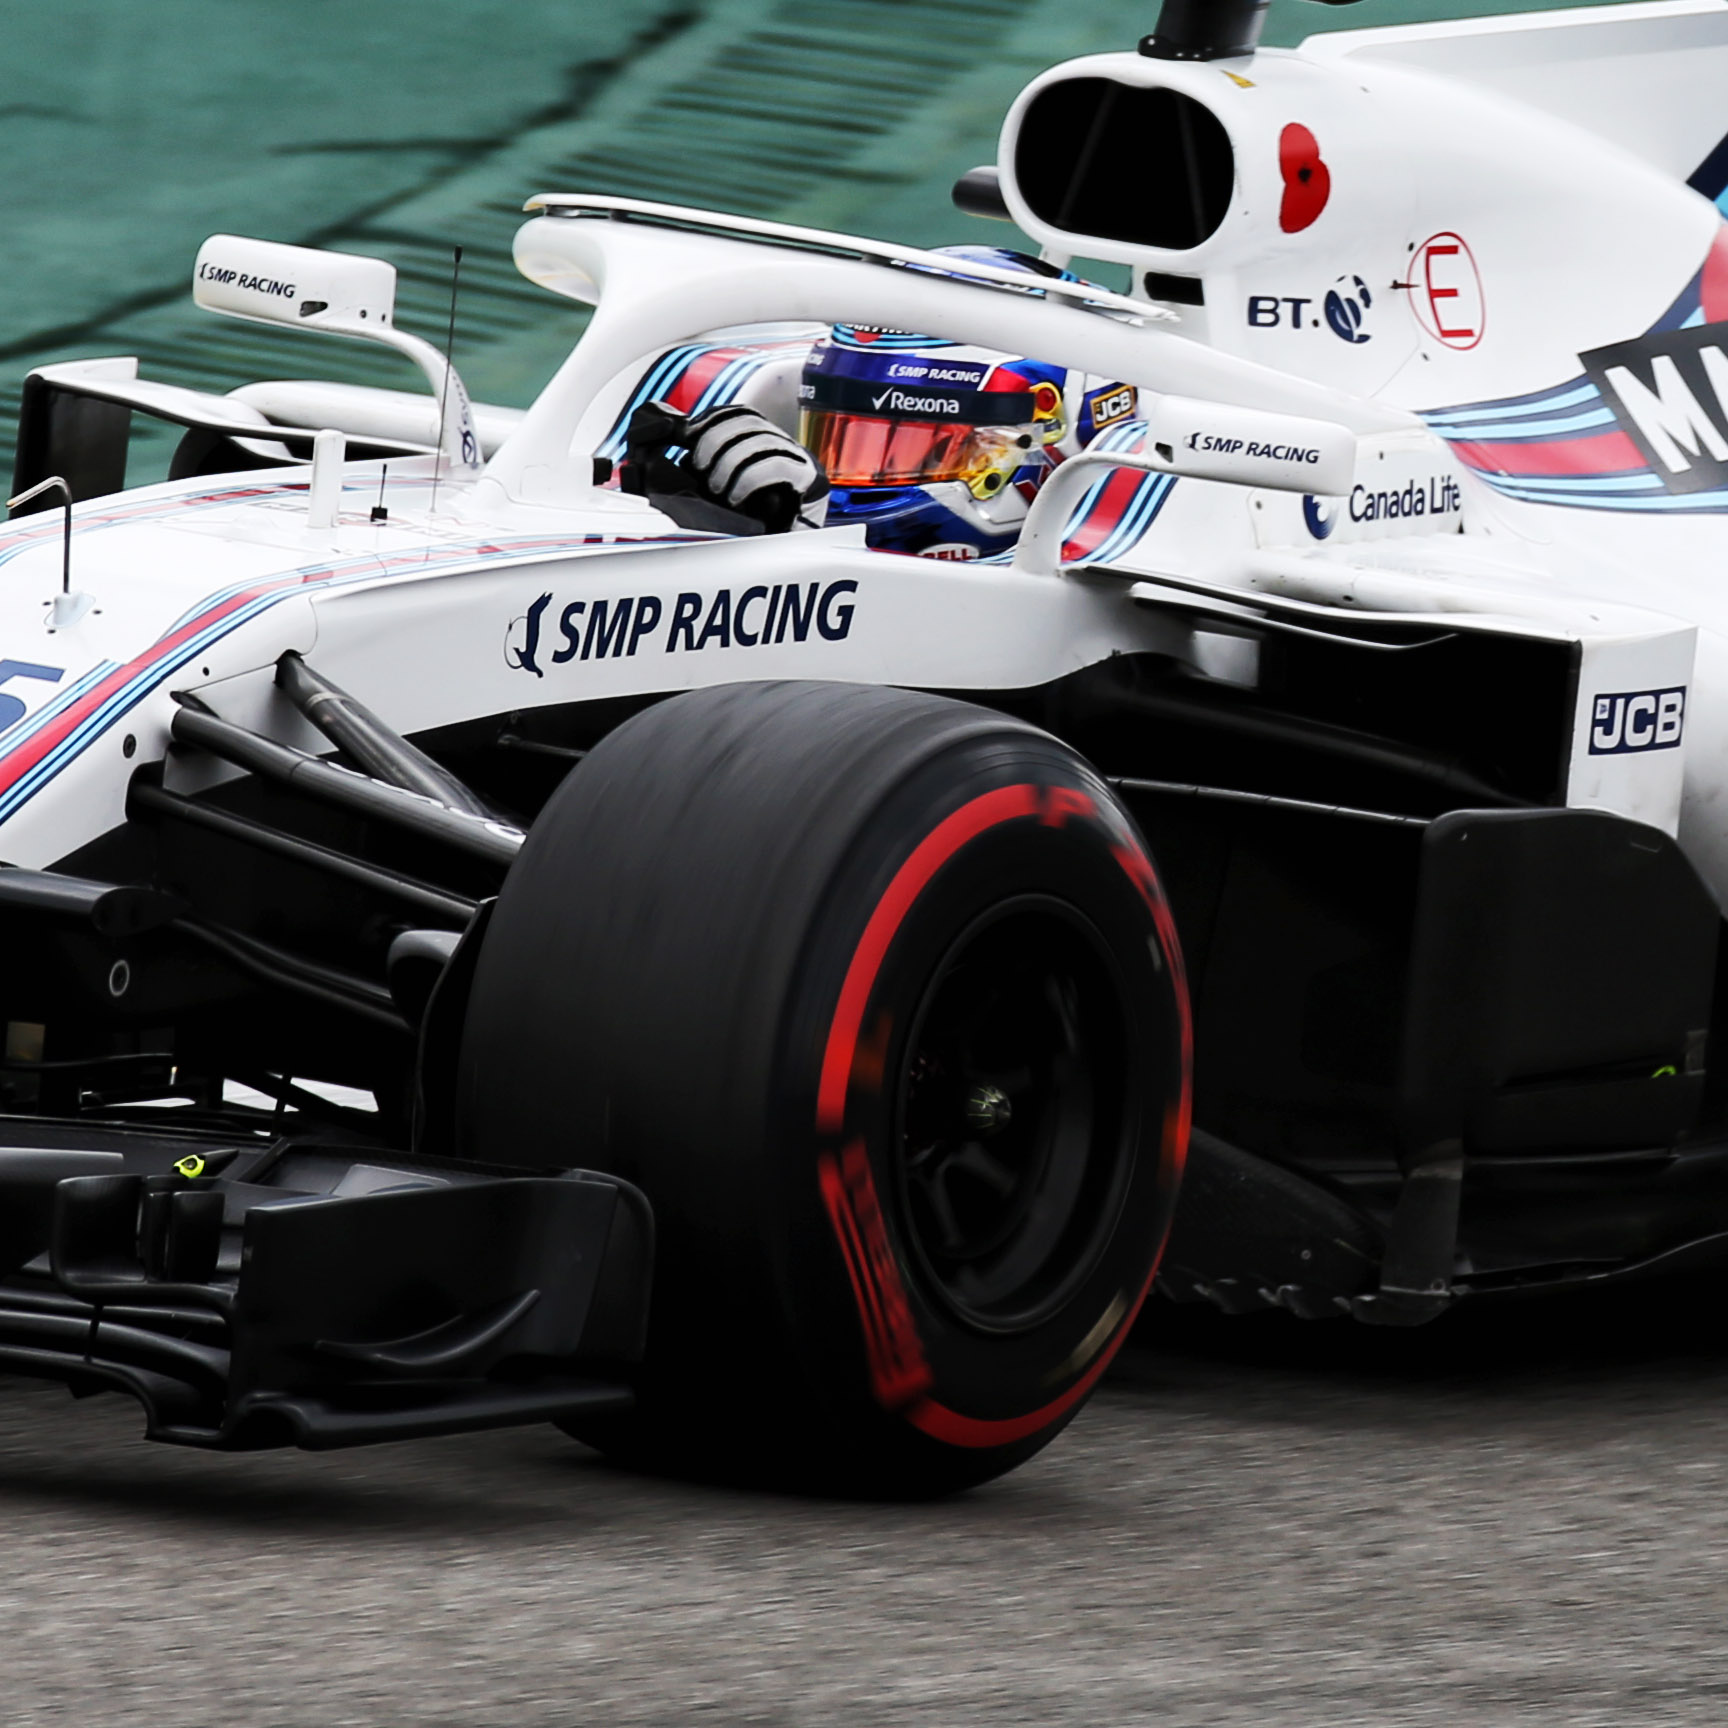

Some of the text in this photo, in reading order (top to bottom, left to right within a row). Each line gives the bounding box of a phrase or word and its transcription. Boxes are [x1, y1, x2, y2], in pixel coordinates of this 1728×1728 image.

[207, 266, 296, 299] SMP RACING
[1425, 244, 1475, 338] E
[1248, 296, 1311, 328] BT
[897, 365, 981, 383] SMP RACING
[890, 391, 960, 414] Rexona
[1095, 391, 1132, 422] JCB
[1201, 436, 1320, 464] SMP RACING
[1349, 476, 1461, 522] Canada Life
[552, 580, 859, 663] SMP RACING
[1593, 692, 1683, 749] JCB
